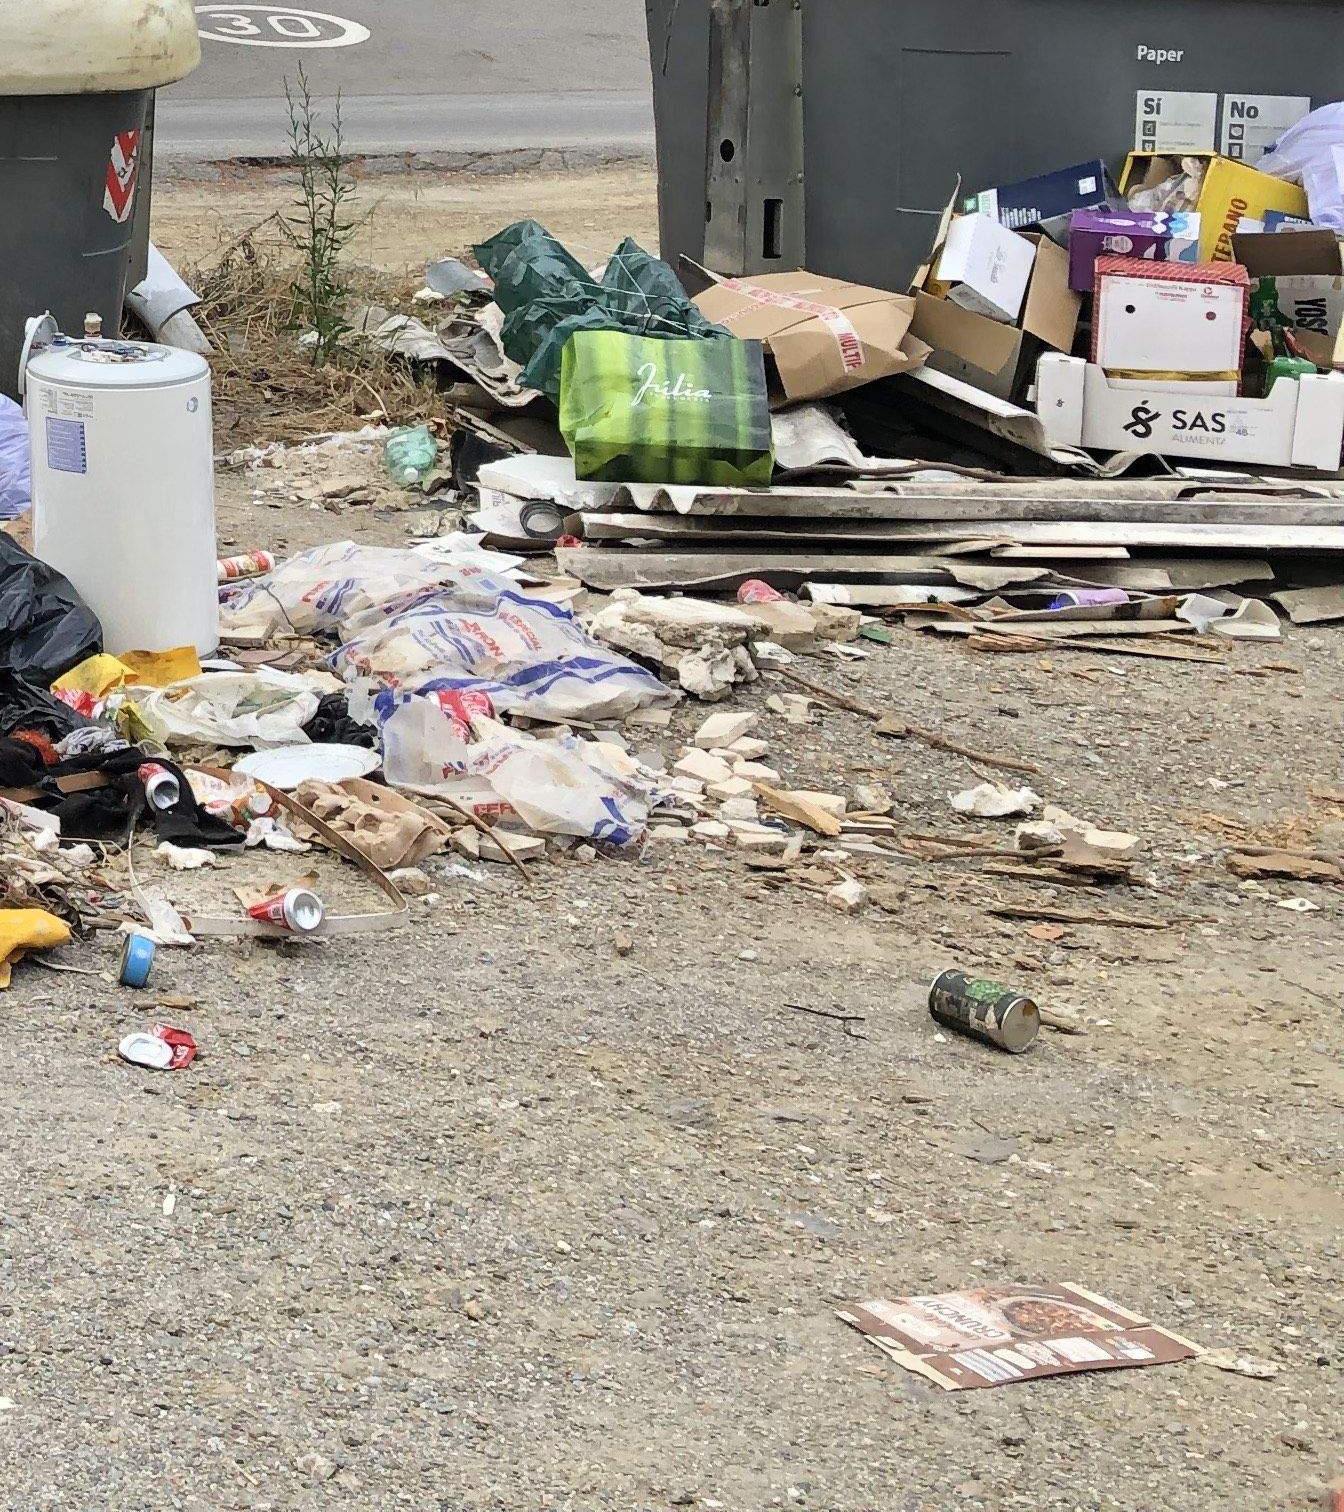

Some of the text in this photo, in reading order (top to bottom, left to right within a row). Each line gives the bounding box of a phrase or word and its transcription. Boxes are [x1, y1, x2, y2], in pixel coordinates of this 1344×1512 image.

[209, 13, 321, 38] 30
[1137, 45, 1184, 64] Paper
[1143, 97, 1163, 115] Sí
[1230, 100, 1260, 119] No
[1172, 409, 1226, 433] SAS
